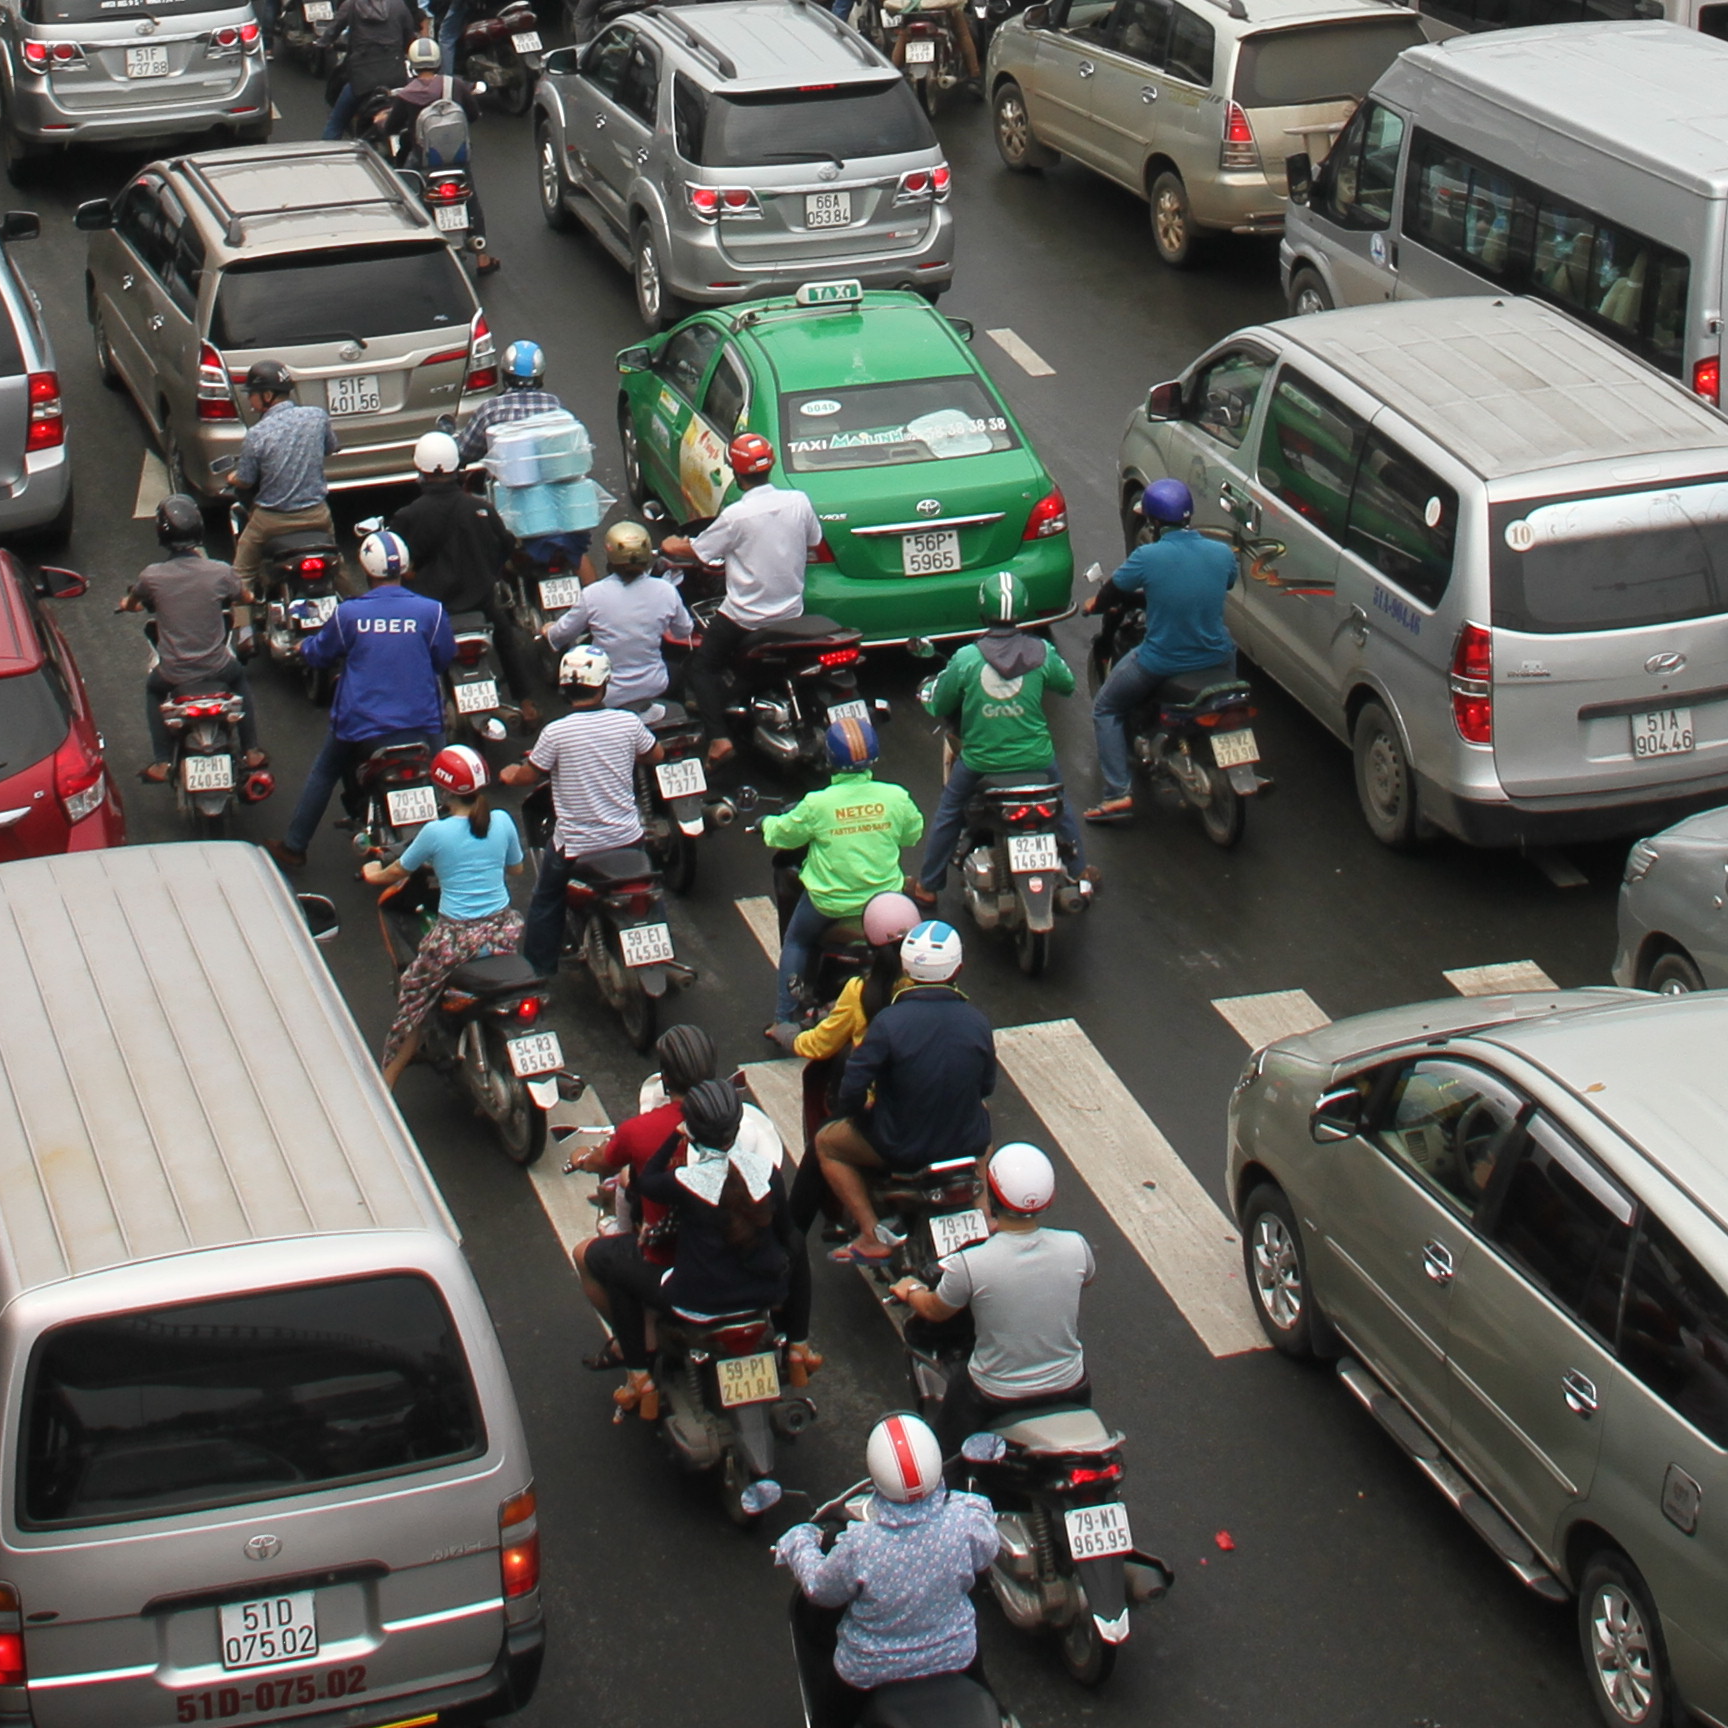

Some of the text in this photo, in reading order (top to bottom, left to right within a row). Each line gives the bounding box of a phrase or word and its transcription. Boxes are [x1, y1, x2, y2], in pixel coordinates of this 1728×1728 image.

[135, 48, 158, 61] 51F
[128, 60, 168, 74] 737.88
[815, 194, 840, 210] 66A
[808, 208, 850, 225] 053.84
[338, 379, 364, 395] 51F
[330, 393, 381, 413] 401.56
[787, 436, 828, 453] TAXI
[914, 531, 946, 553] 56P
[1511, 525, 1531, 545] 10
[910, 550, 955, 573] 5965
[357, 618, 417, 633] UBER
[455, 696, 498, 713] 345.05
[981, 701, 1024, 718] Grab
[1647, 709, 1680, 732] 51A
[1637, 730, 1693, 755] 904.46
[192, 757, 226, 772] 73-H1
[189, 772, 230, 789] 240.59
[666, 776, 699, 795] 7377
[835, 803, 885, 820] NETCO
[1013, 852, 1055, 870] 146.97
[627, 928, 661, 946] 59-E1
[626, 943, 670, 964] 145.96
[515, 1036, 552, 1057] 54-R3
[520, 1053, 558, 1072] 8549
[938, 1214, 977, 1233] 79-T2
[725, 1361, 766, 1380] 59-P1
[724, 1378, 777, 1403] 241.84
[1074, 1509, 1117, 1532] 79-N1
[1073, 1530, 1129, 1556] 965.95
[242, 1597, 294, 1632] 51D
[225, 1623, 315, 1665] 075.02
[176, 1668, 368, 1725] 51D-075.02
